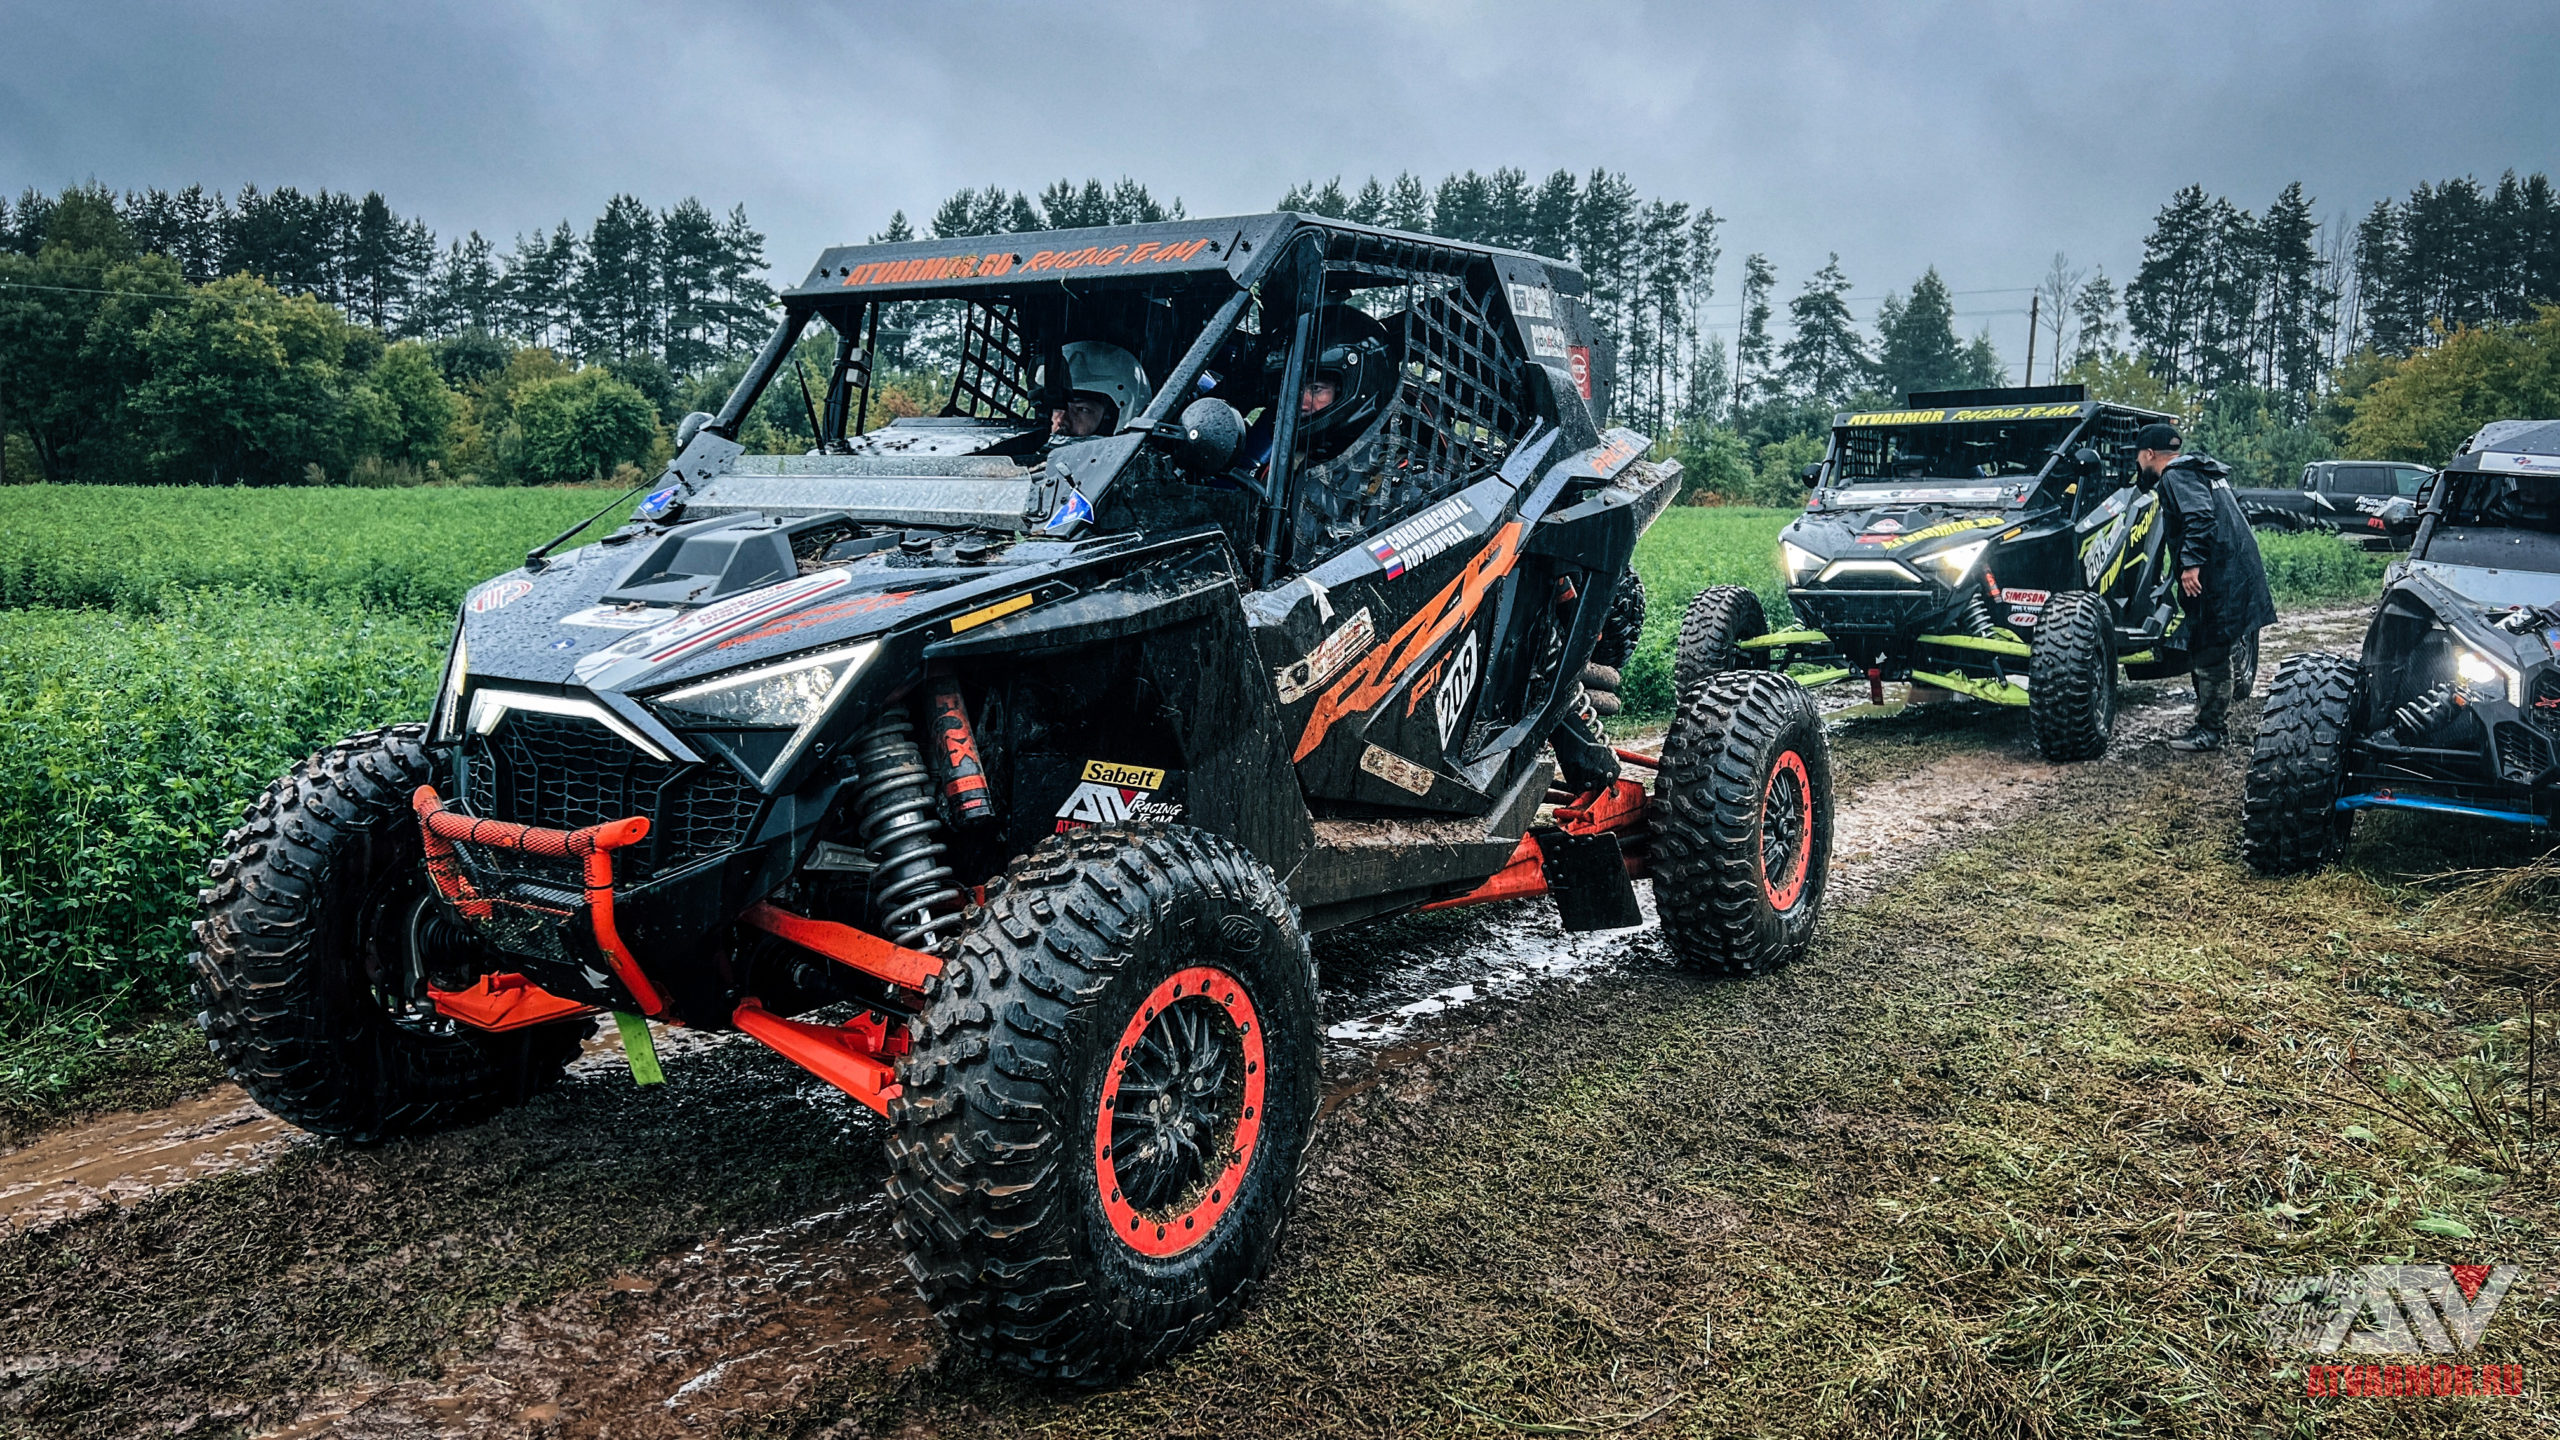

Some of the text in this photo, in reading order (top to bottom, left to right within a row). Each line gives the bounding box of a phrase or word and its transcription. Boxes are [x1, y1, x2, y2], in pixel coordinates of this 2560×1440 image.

[842, 238, 1209, 287] ATVARMOR.RU RACING TEAM
[1847, 404, 2080, 427] ATVARMOR RACING TEAM
[1385, 499, 1465, 551] СОКОЛЯНСКИЙ
[1399, 525, 1466, 572] КОРЯВИЧЕВ
[2004, 591, 2047, 603] SIMPSON
[1440, 645, 1473, 740] 209
[1088, 763, 1157, 787] Sabelt
[1132, 800, 1183, 816] RACING
[1138, 813, 1174, 823] TEAM
